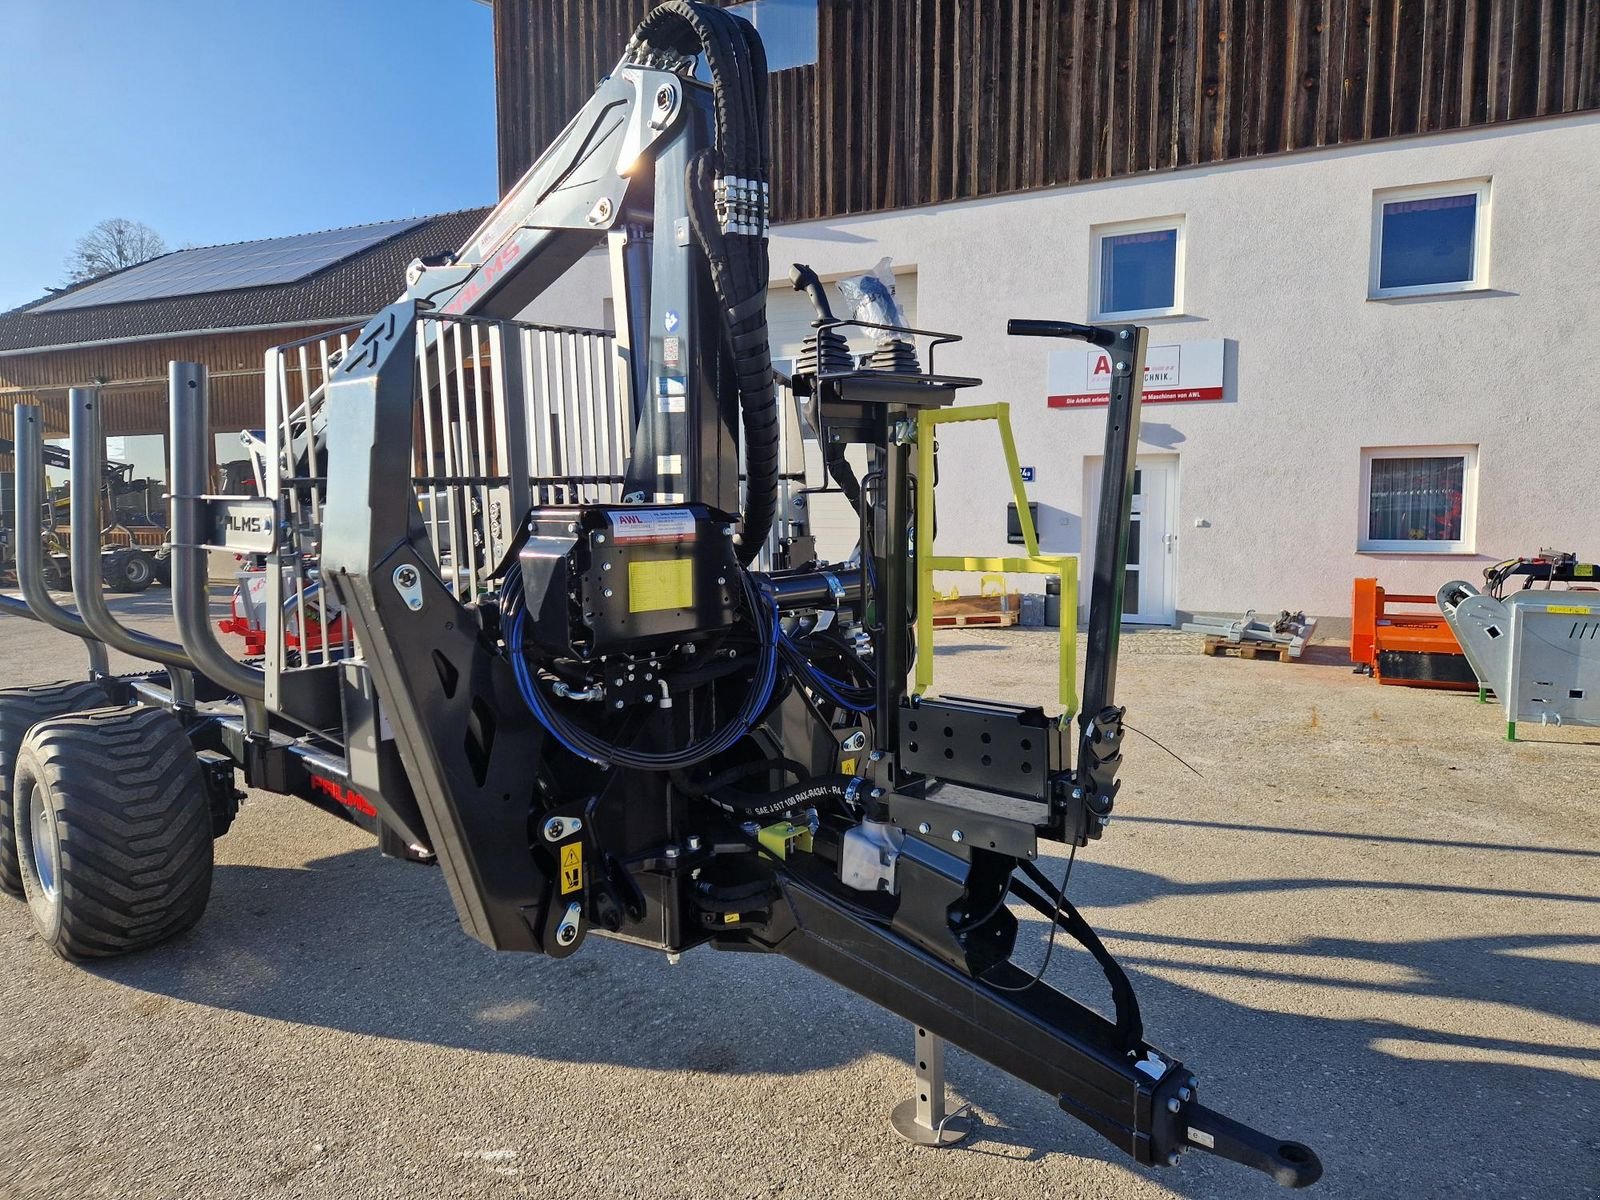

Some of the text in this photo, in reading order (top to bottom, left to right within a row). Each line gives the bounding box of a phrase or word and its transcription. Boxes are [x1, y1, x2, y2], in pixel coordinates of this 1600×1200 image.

[1144, 372, 1168, 382] CHNIK
[1147, 392, 1176, 400] Maschinen
[619, 515, 643, 525] AWL
[311, 774, 378, 817] PALMS
[754, 806, 769, 816] SAE
[775, 801, 785, 811] 517
[784, 797, 796, 807] 100
